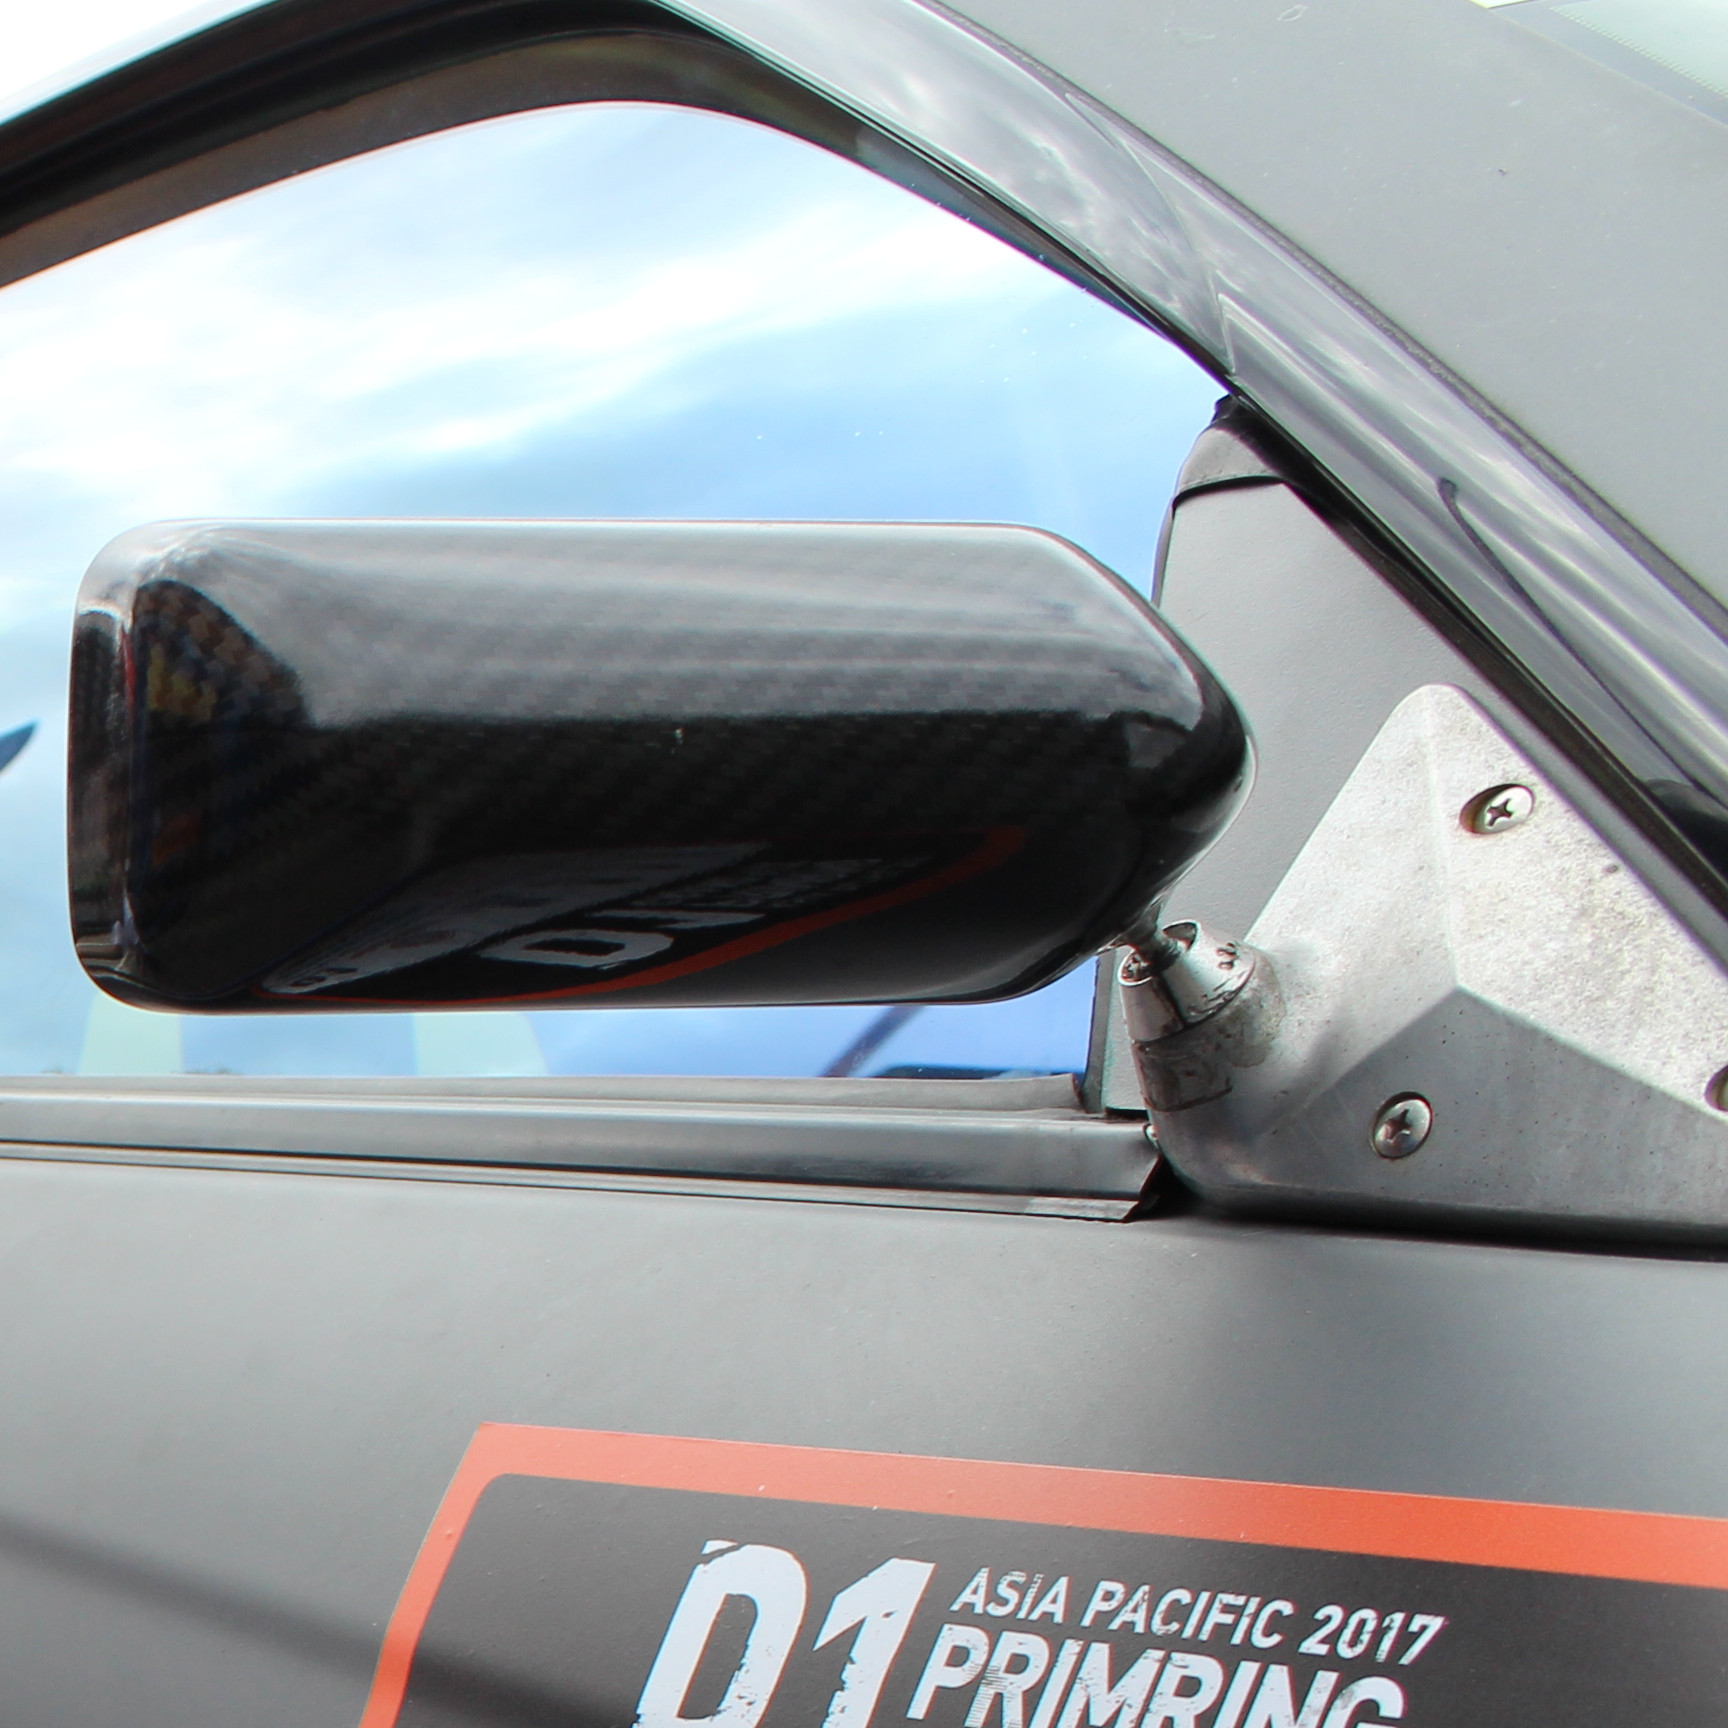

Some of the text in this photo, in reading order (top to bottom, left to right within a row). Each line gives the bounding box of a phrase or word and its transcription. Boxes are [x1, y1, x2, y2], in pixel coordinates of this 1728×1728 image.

[949, 1567, 1448, 1666] ASIA PACIFIC 2017
